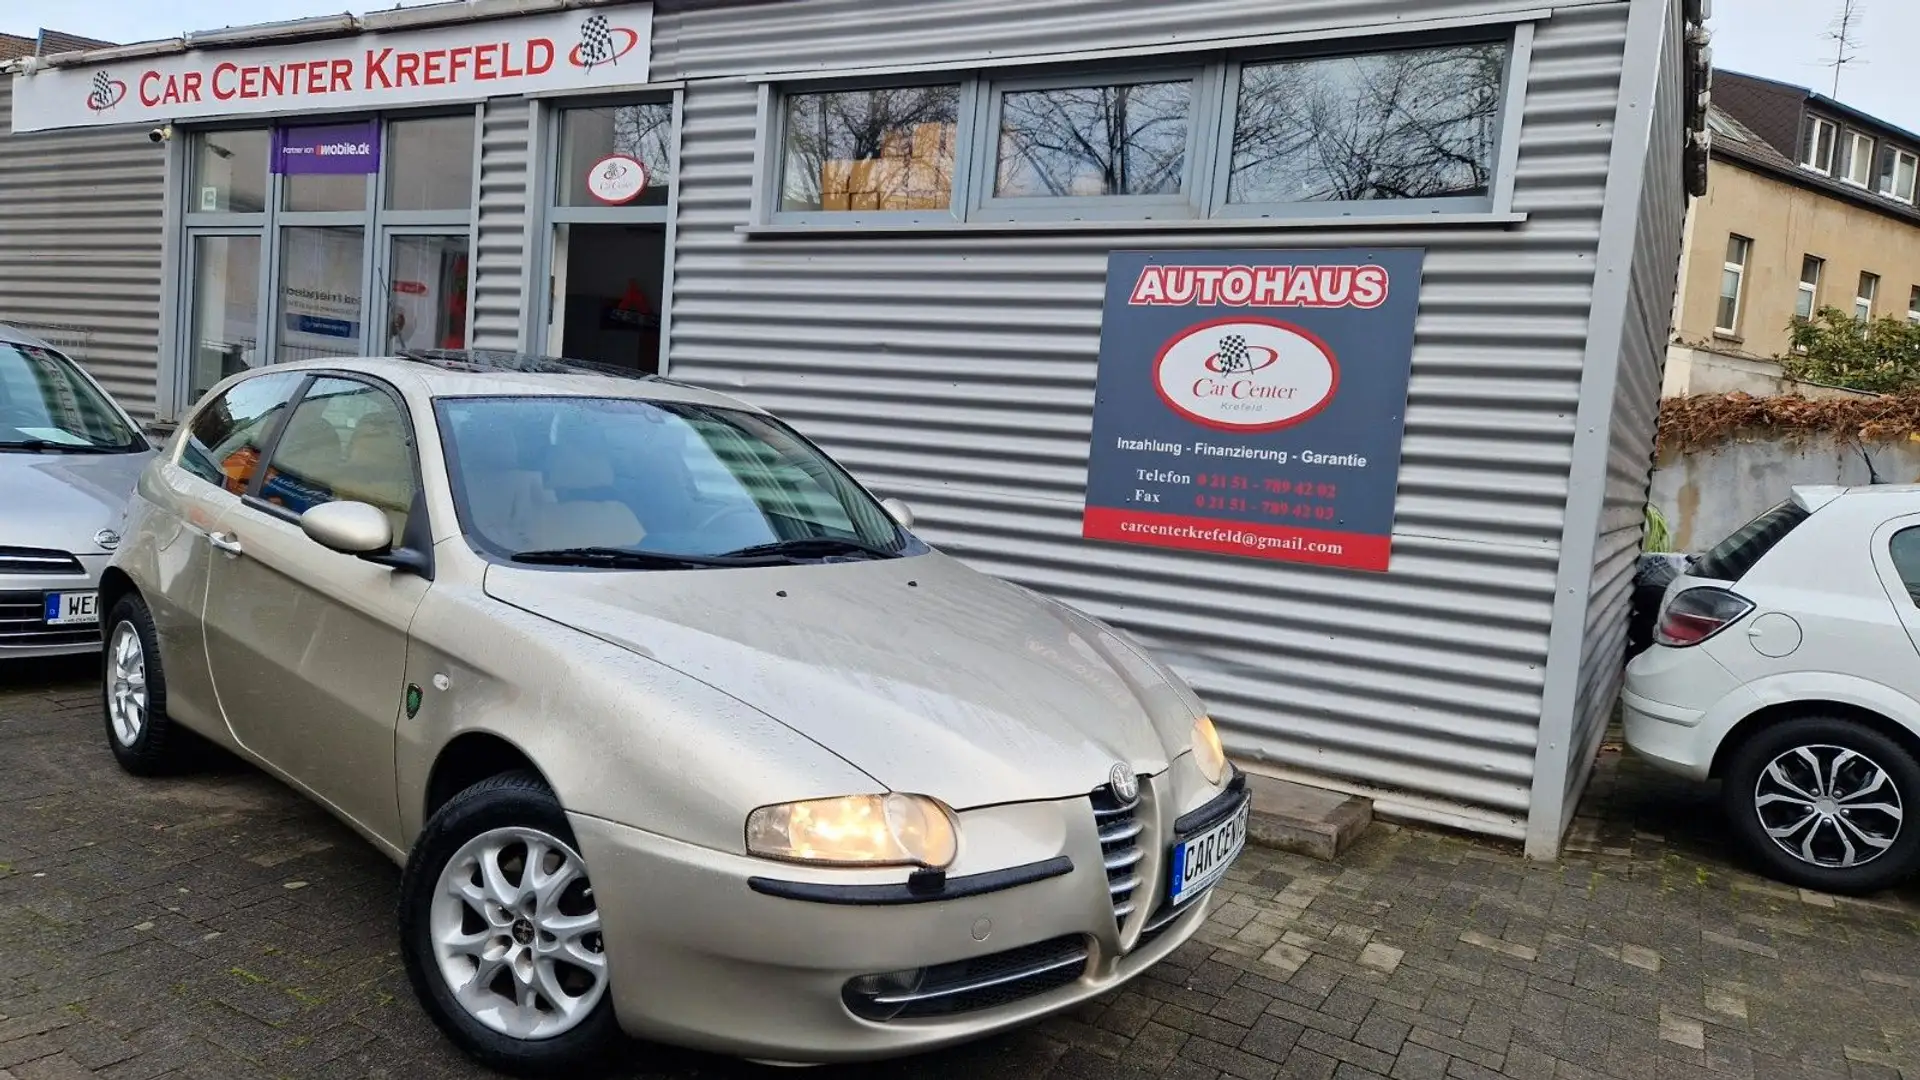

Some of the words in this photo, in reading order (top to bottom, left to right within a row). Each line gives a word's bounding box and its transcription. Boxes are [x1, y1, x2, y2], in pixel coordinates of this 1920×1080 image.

[139, 71, 202, 107] CAR
[212, 59, 353, 101] CENTER
[365, 38, 555, 90] KREFELD
[1128, 265, 1389, 309] AUTOHAUS
[1192, 378, 1228, 398] Car
[1231, 380, 1298, 399] Center
[1220, 402, 1263, 412] Krefeld
[1117, 437, 1182, 456] Inzahlung
[1194, 442, 1288, 464] Finanzierung
[1301, 450, 1367, 468] Garantie
[1136, 469, 1190, 484] Telefon
[1135, 488, 1160, 503] Fax
[1121, 520, 1343, 555] carcenterkrefeld@gmail.com
[1185, 833, 1215, 881] CAR
